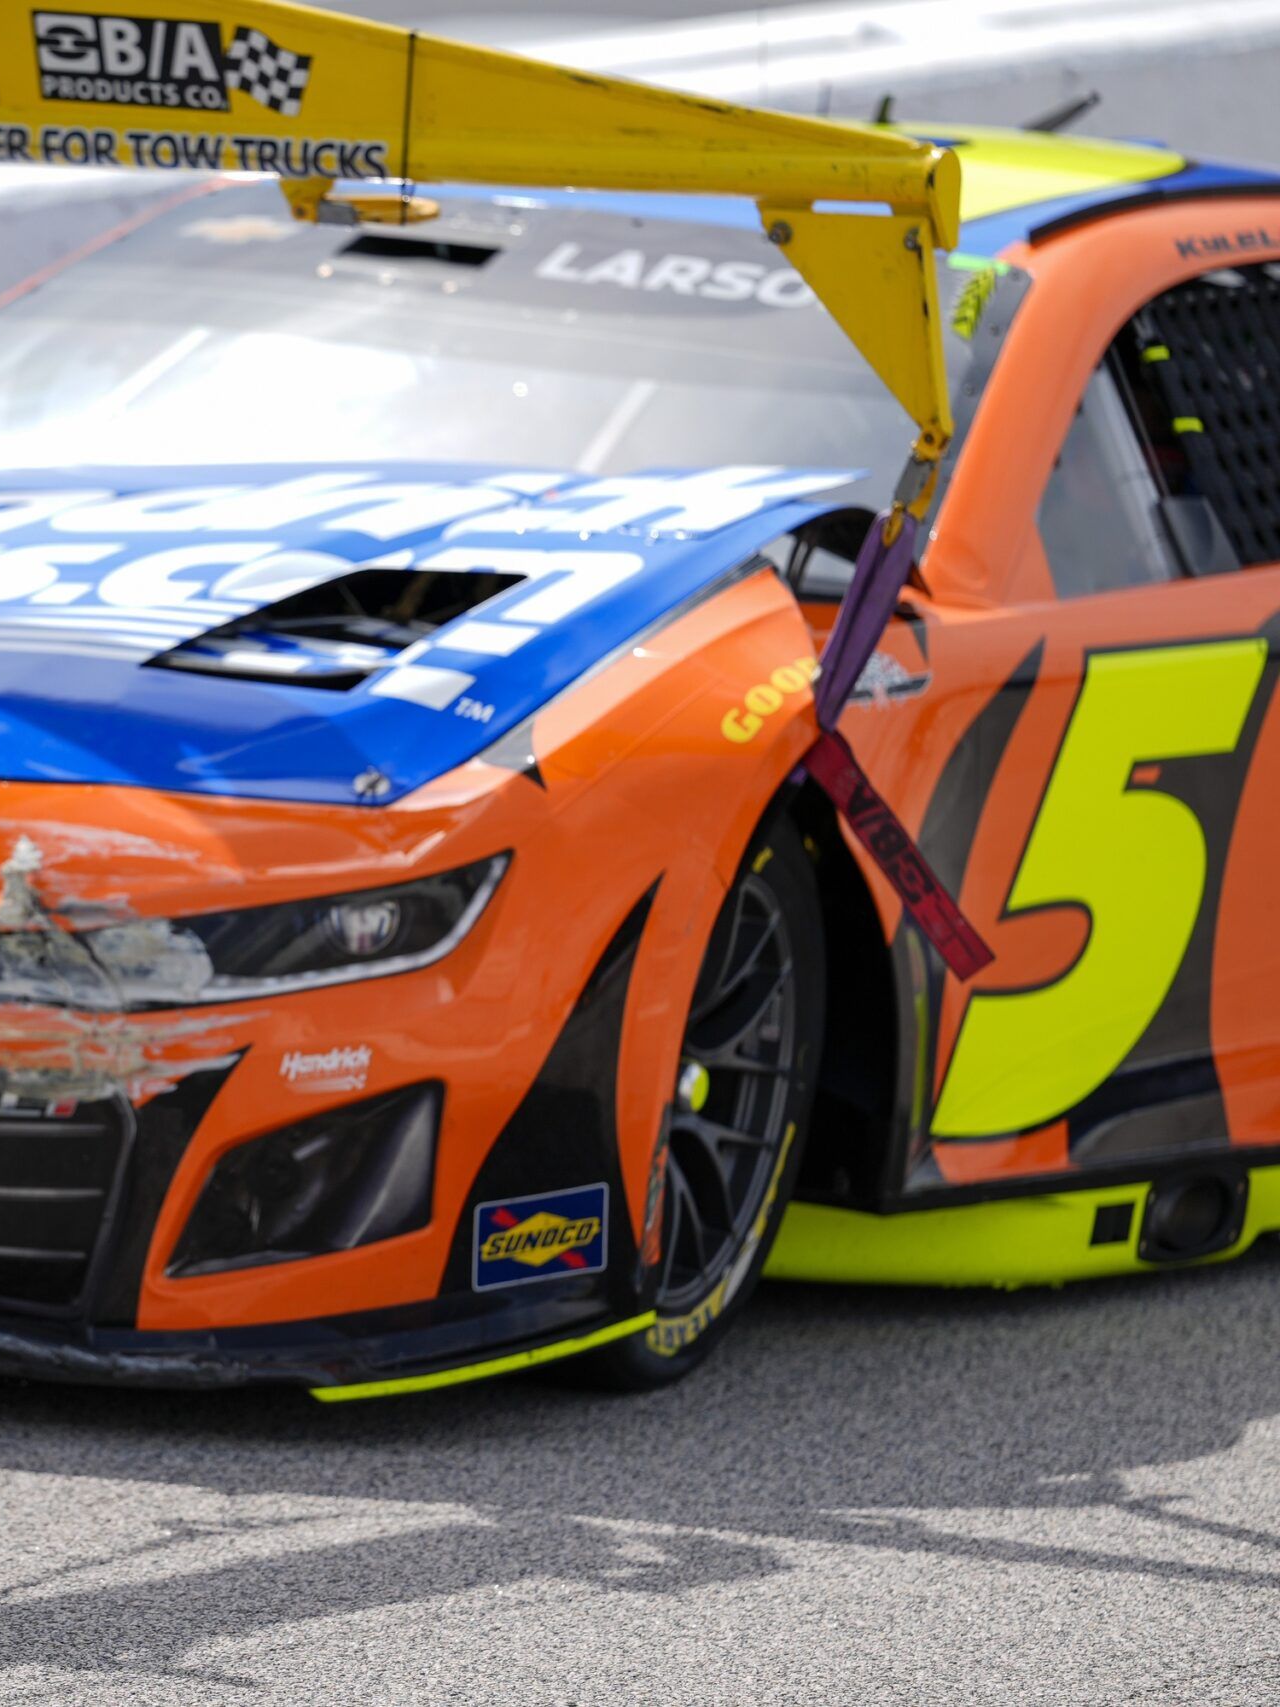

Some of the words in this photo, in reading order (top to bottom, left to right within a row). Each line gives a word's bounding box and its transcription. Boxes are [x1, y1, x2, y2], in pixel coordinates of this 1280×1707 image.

[41, 76, 180, 107] PRODUCTS
[184, 86, 230, 112] CO.
[41, 128, 116, 167] FOR
[126, 131, 224, 171] TOW
[233, 138, 388, 179] TRUCKS
[534, 242, 822, 309] LARSO
[454, 697, 496, 724] TM
[929, 637, 1269, 1138] 5
[486, 1222, 594, 1257] SUNOCO
